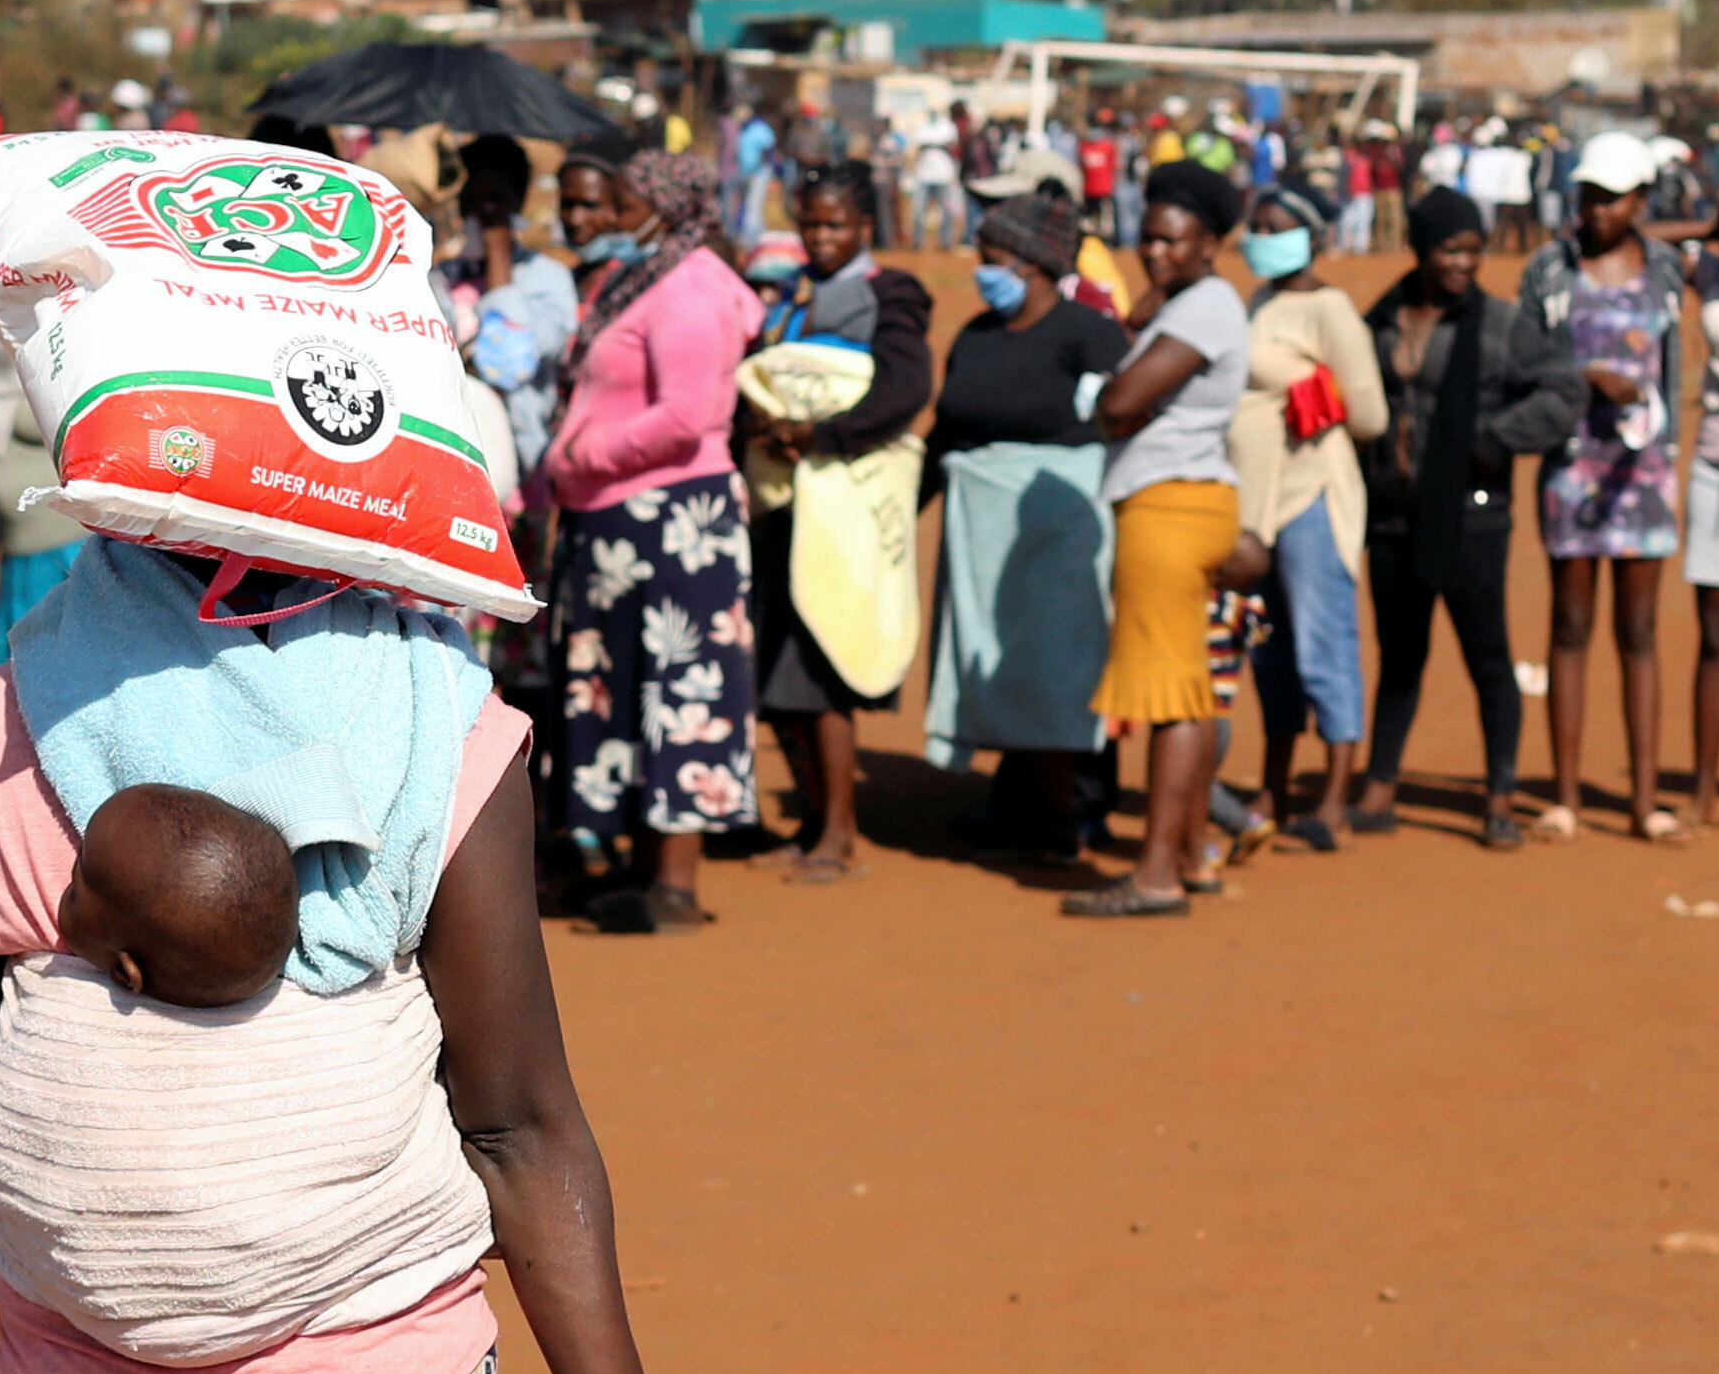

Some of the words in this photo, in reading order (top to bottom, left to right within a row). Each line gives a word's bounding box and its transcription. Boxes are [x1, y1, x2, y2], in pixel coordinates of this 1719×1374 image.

[153, 279, 245, 311] MEAL
[255, 294, 357, 324] MAIZE
[290, 334, 328, 346] BETTER
[332, 335, 354, 353] FOR
[359, 351, 397, 407] FORTIFIED
[250, 466, 306, 495] SUPER
[307, 480, 363, 509] MAIZE
[363, 492, 408, 521] MEAL
[456, 523, 478, 539] 12.5
[480, 530, 494, 551] kg
